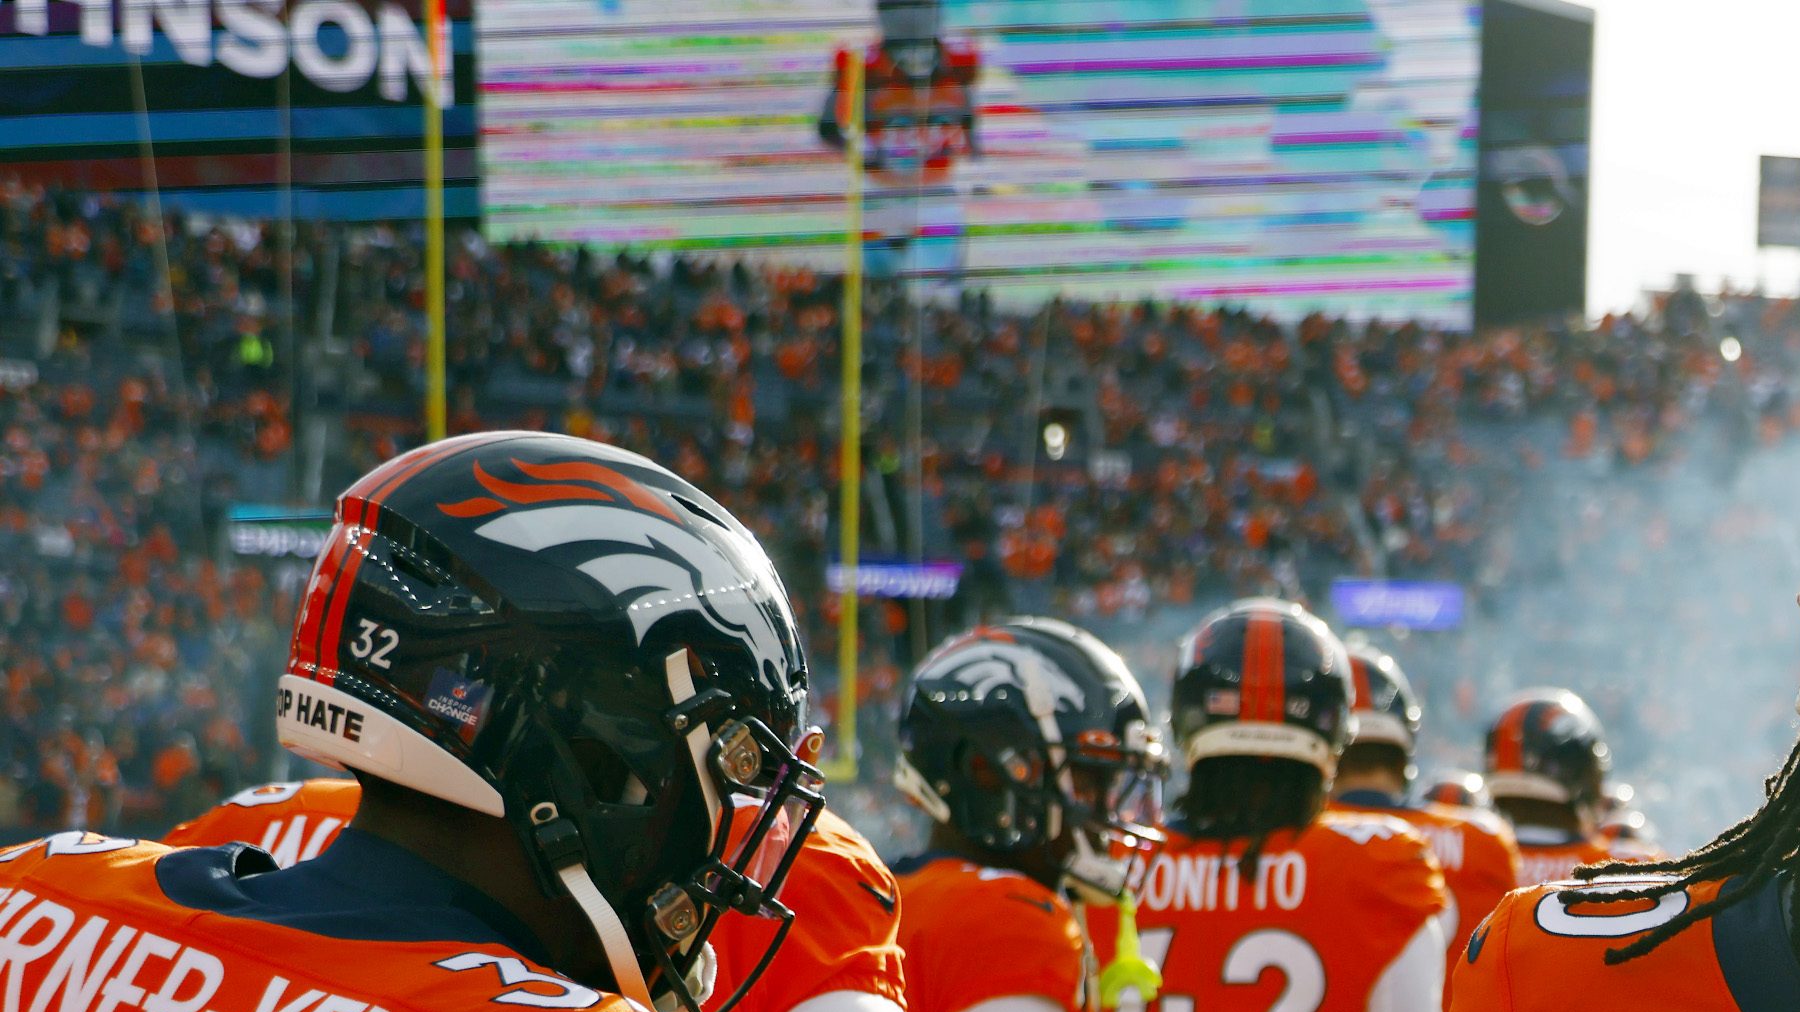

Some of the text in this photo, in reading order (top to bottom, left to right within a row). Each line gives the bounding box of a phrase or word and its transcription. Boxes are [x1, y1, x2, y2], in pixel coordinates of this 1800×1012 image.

[351, 618, 400, 669] 32
[296, 692, 365, 743] HATE
[428, 698, 478, 726] CHANGE
[439, 695, 473, 713] INSPIRE
